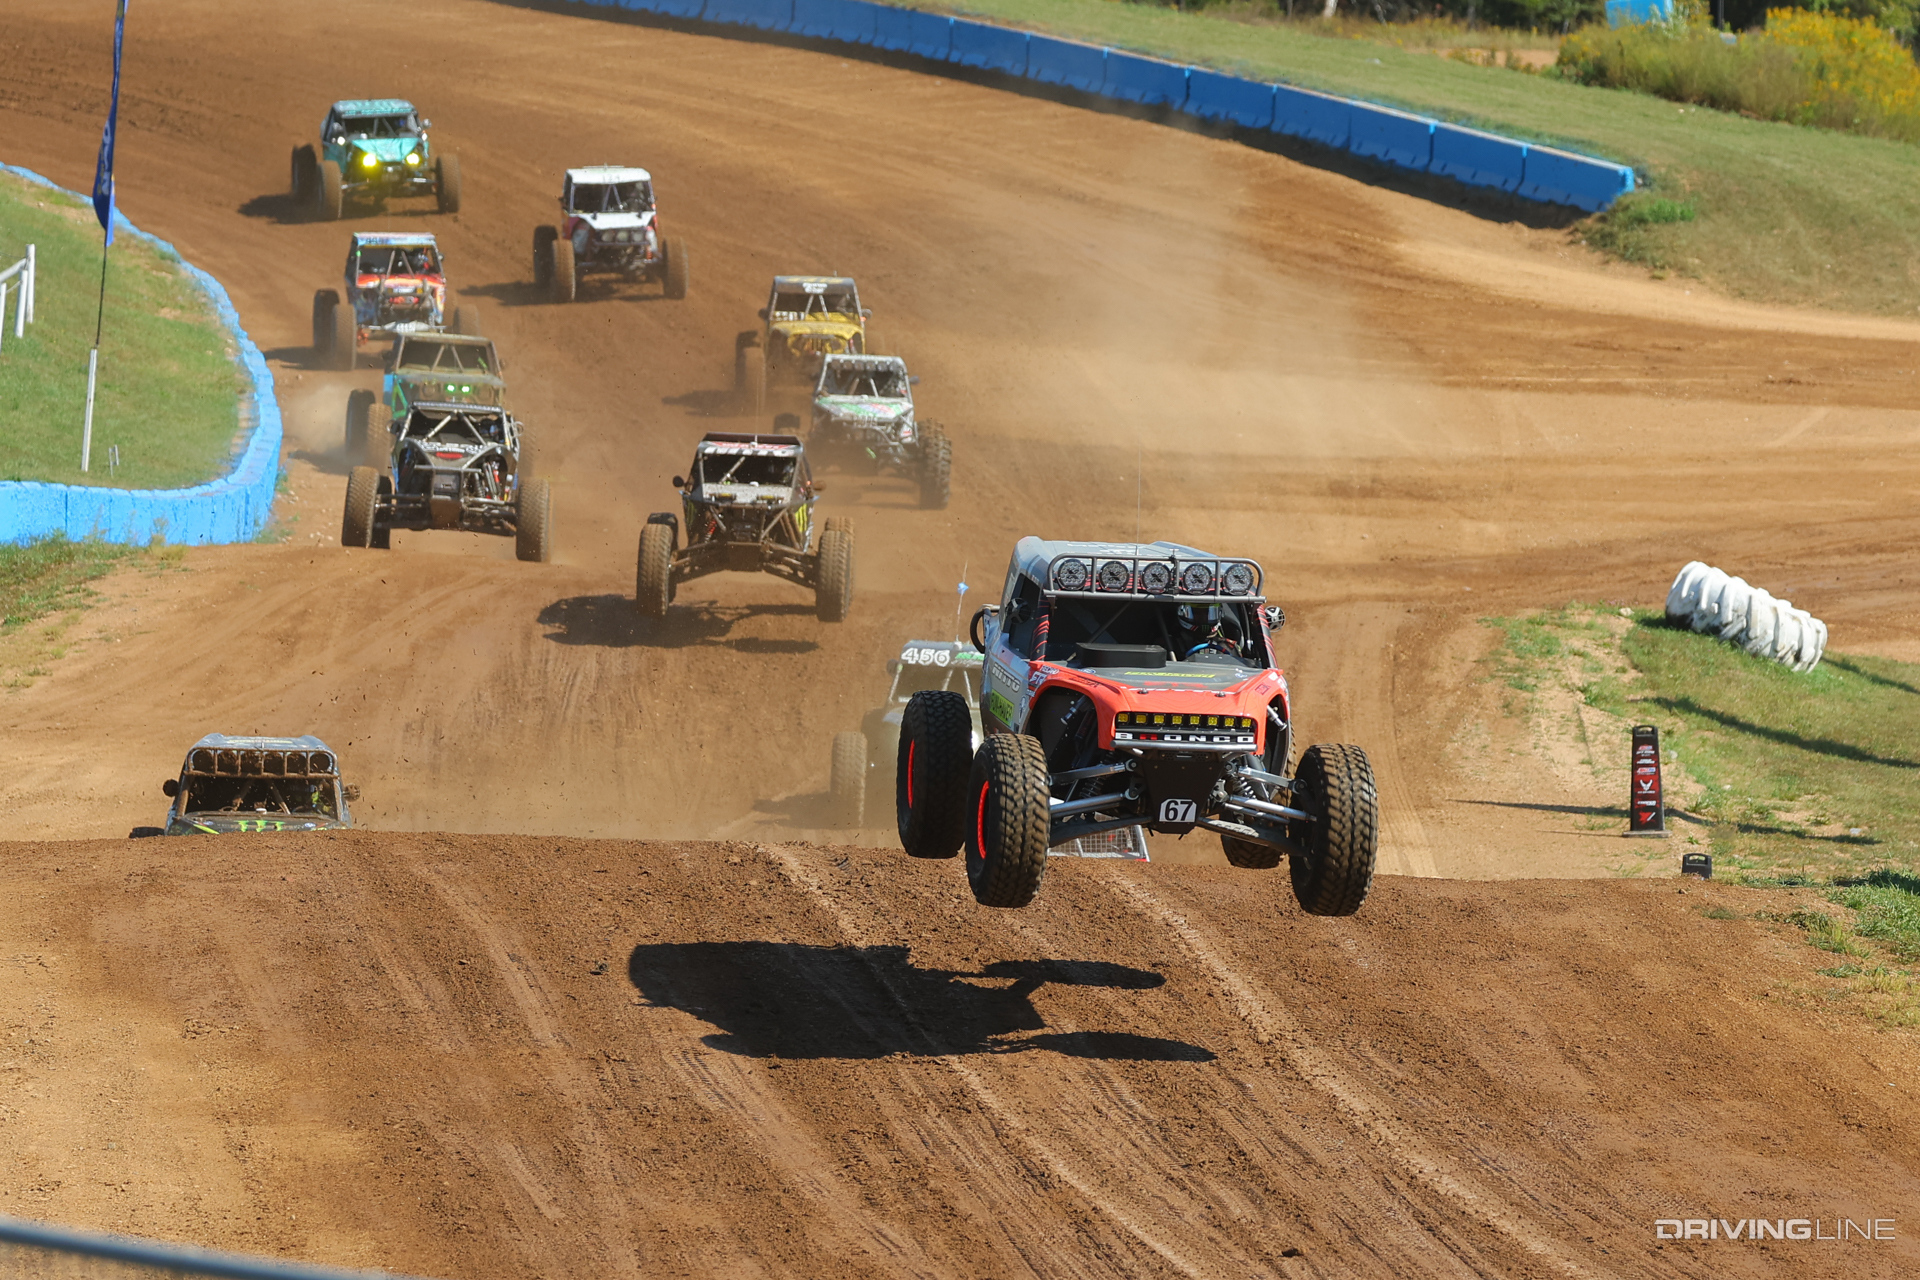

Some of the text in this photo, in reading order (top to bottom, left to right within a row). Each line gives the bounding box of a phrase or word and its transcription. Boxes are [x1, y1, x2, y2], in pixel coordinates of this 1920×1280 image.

[901, 648, 950, 667] 456
[992, 663, 1020, 692] NITTO
[1115, 732, 1254, 743] BRONCO
[1165, 800, 1193, 821] 67
